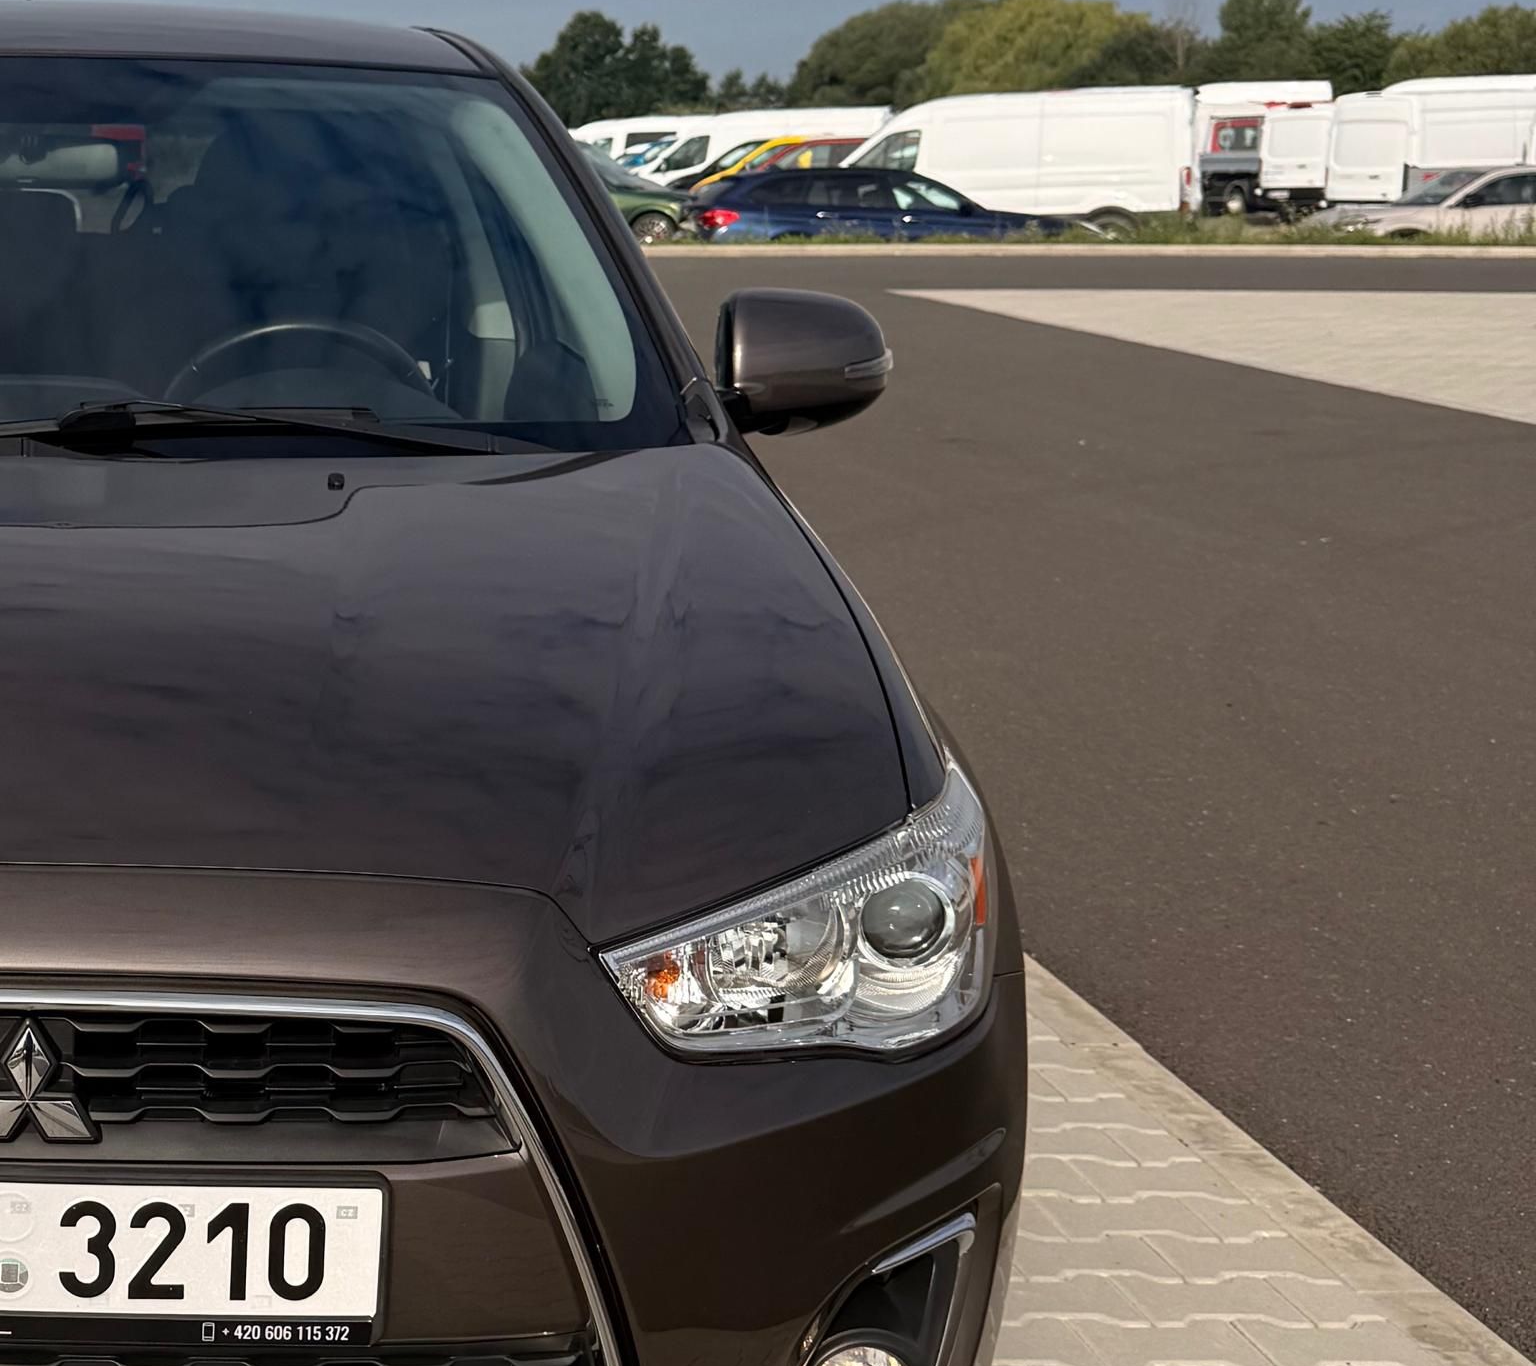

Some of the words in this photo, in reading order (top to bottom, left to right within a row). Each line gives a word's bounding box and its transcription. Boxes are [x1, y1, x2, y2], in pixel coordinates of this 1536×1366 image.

[59, 1200, 327, 1302] 3210
[233, 1324, 261, 1340] 420
[264, 1325, 293, 1341] 606
[296, 1326, 322, 1341] 115
[325, 1326, 350, 1341] 372
